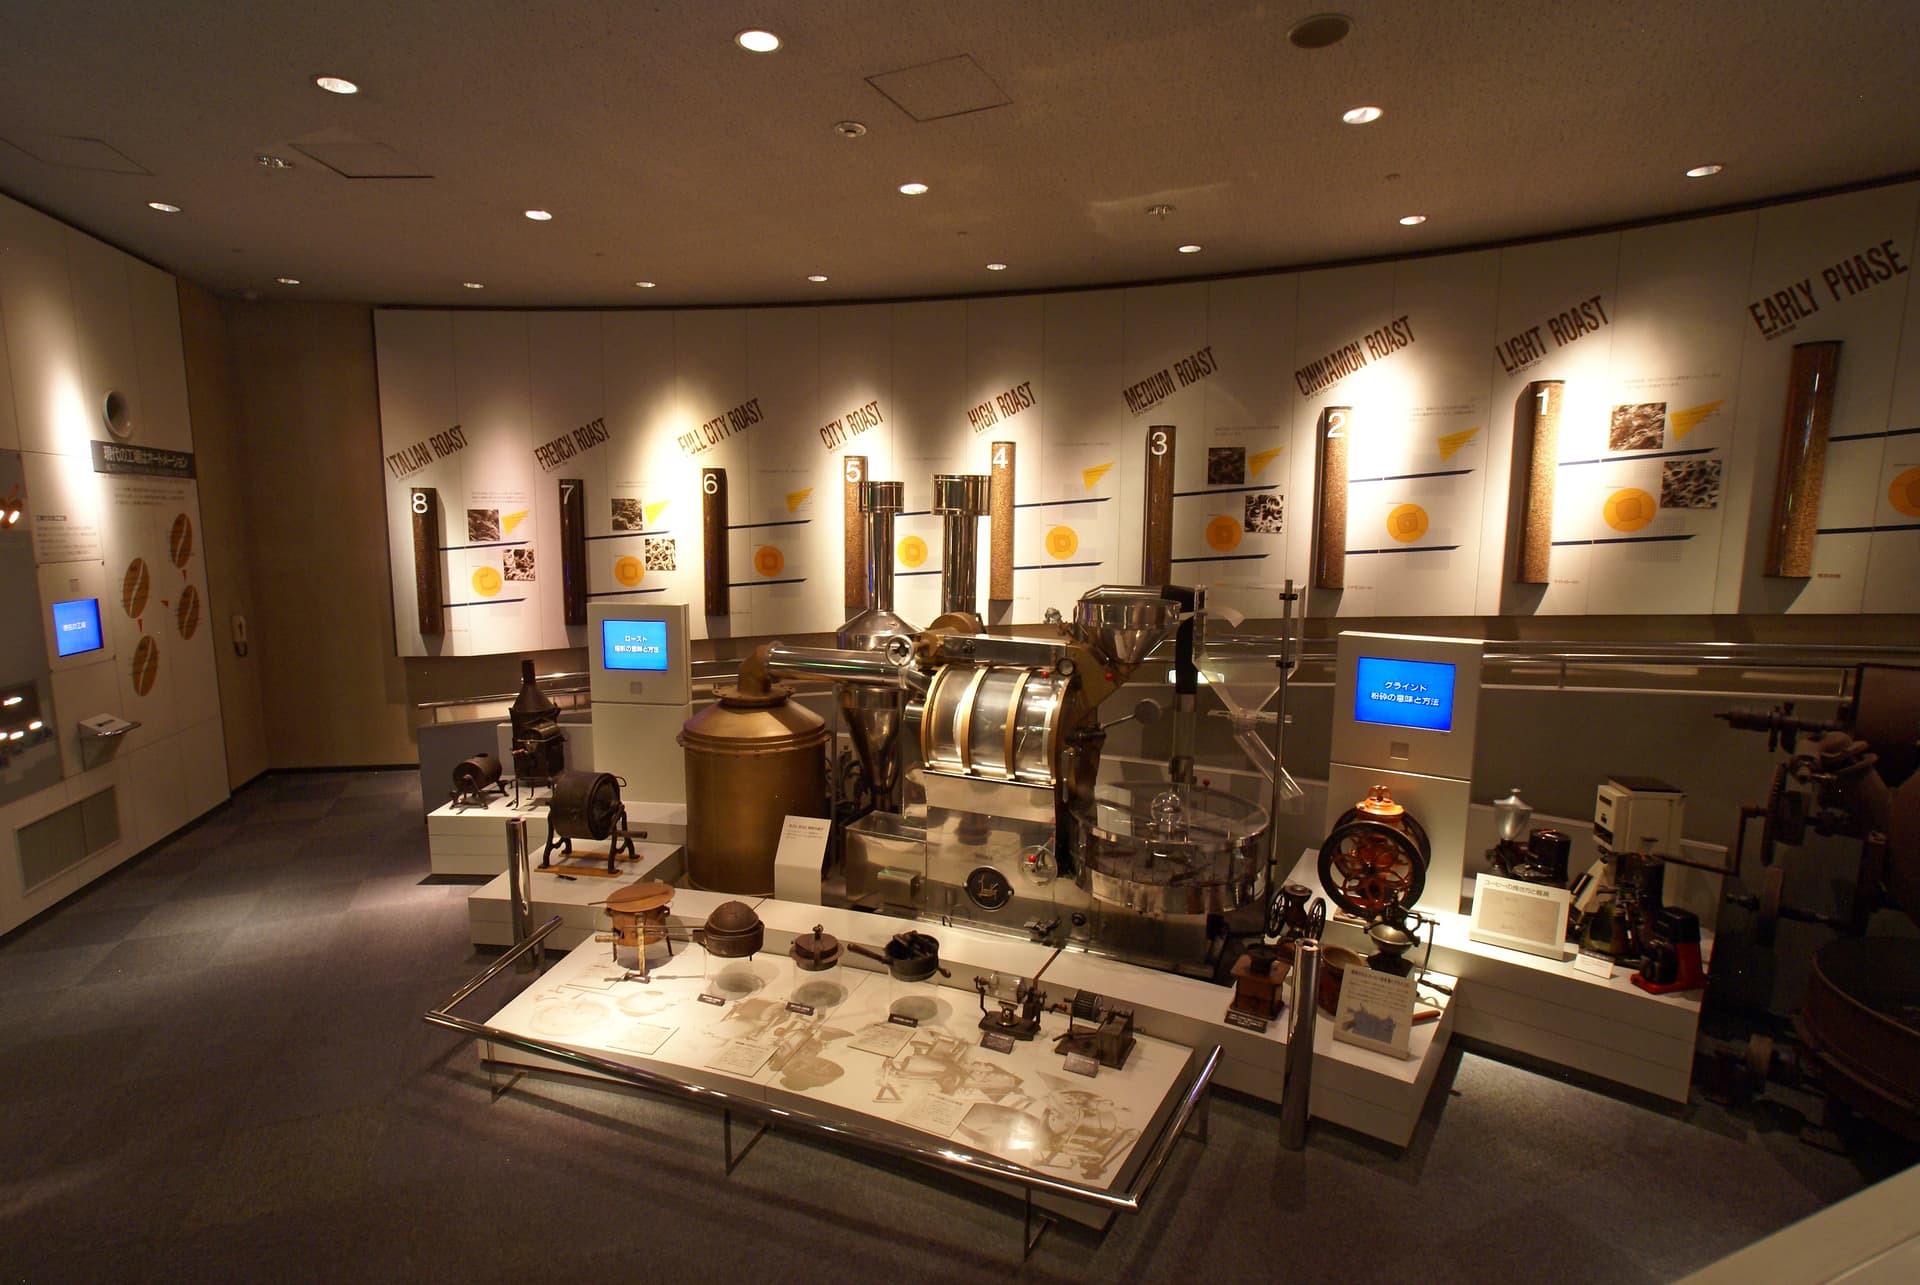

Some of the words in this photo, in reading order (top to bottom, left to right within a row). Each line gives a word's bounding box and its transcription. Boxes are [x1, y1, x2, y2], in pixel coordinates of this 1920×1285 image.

[1748, 279, 1820, 336] EARLY
[1822, 240, 1909, 301] PHASE
[1495, 326, 1547, 372] LIGHT
[1547, 296, 1610, 348] ROAST
[1295, 341, 1368, 397] CINNAMON
[1365, 315, 1416, 361] ROAST
[1122, 369, 1176, 414] MEDIUM
[1174, 346, 1218, 388] ROAST
[967, 404, 997, 432] HIGH
[996, 381, 1037, 419] ROAST
[1536, 388, 1549, 415] 1
[678, 429, 707, 457] FULL
[703, 412, 730, 446] CITY
[727, 399, 764, 436] ROAST
[819, 422, 849, 449] CITY
[846, 401, 884, 436] ROAST
[1152, 432, 1167, 455] 3
[1327, 413, 1345, 437] 2
[386, 442, 433, 479] ITALIAN
[428, 425, 468, 459] ROAST
[534, 434, 575, 470] FRENCH
[573, 418, 610, 453] ROAST
[993, 447, 1008, 468] 4
[704, 474, 718, 494] 6
[846, 461, 860, 482] 5
[413, 493, 428, 513] 8
[561, 485, 575, 504] 7
[625, 635, 647, 643] ロースト
